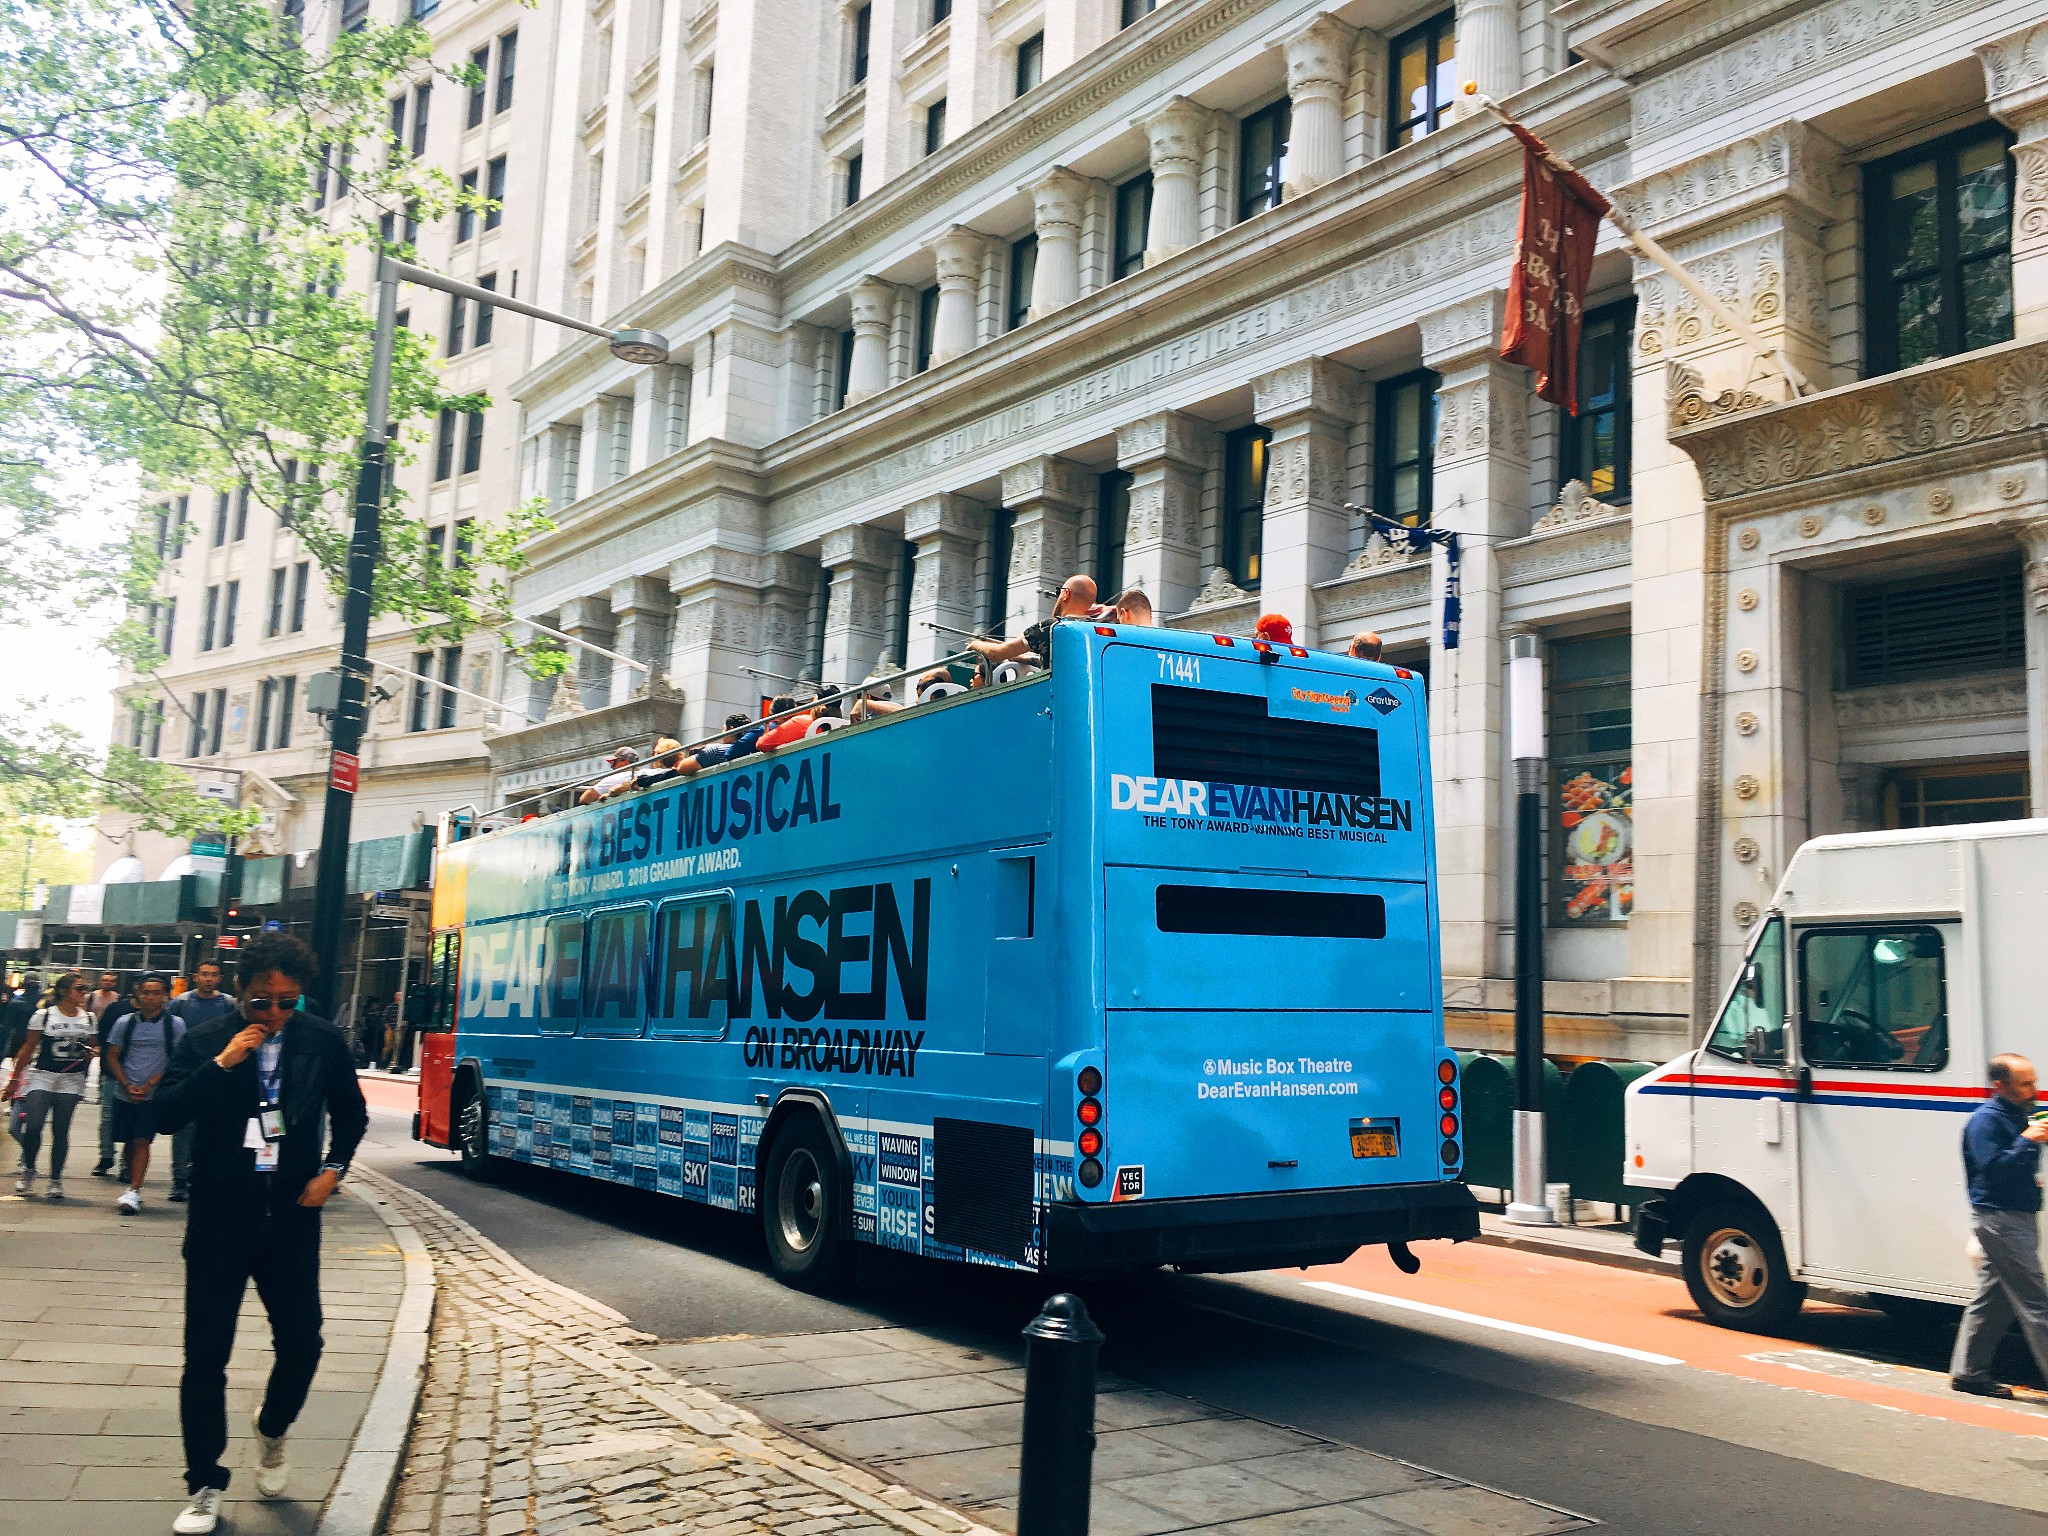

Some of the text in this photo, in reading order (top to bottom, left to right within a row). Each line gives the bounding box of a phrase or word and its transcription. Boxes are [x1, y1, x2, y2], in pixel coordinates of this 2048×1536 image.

[1053, 362, 1133, 418] GREEN
[1151, 306, 1271, 380] OFFICES
[1157, 652, 1201, 683] 71441
[599, 797, 670, 868] BEST
[677, 752, 841, 852] MUSICAL
[1143, 814, 1167, 829] THE
[1171, 816, 1204, 832] TONY
[1307, 827, 1335, 841] BEST
[1339, 829, 1388, 844] MUSICAL
[627, 865, 650, 888] 2018
[649, 855, 696, 883] GRAMMY
[696, 846, 742, 875] AWARD.
[743, 1025, 926, 1078] ON BROADWAY
[1217, 1057, 1353, 1076] Music Box Theatre
[1197, 1081, 1359, 1099] DearEvanHansen.com
[712, 1123, 737, 1137] PERFECT
[853, 1132, 864, 1144] WE
[864, 1133, 876, 1146] SEE
[712, 1136, 736, 1162] DAY
[881, 1136, 918, 1156] WAVING
[684, 1161, 707, 1186] SKY
[853, 1154, 876, 1183] KY
[881, 1163, 918, 1183] WINDOW
[1055, 1159, 1073, 1174] THE
[1122, 1171, 1140, 1181] VEC
[1122, 1181, 1140, 1191] TOR
[881, 1188, 917, 1211] YOU'LL
[858, 1216, 875, 1233] SUN
[880, 1206, 918, 1239] RISE
